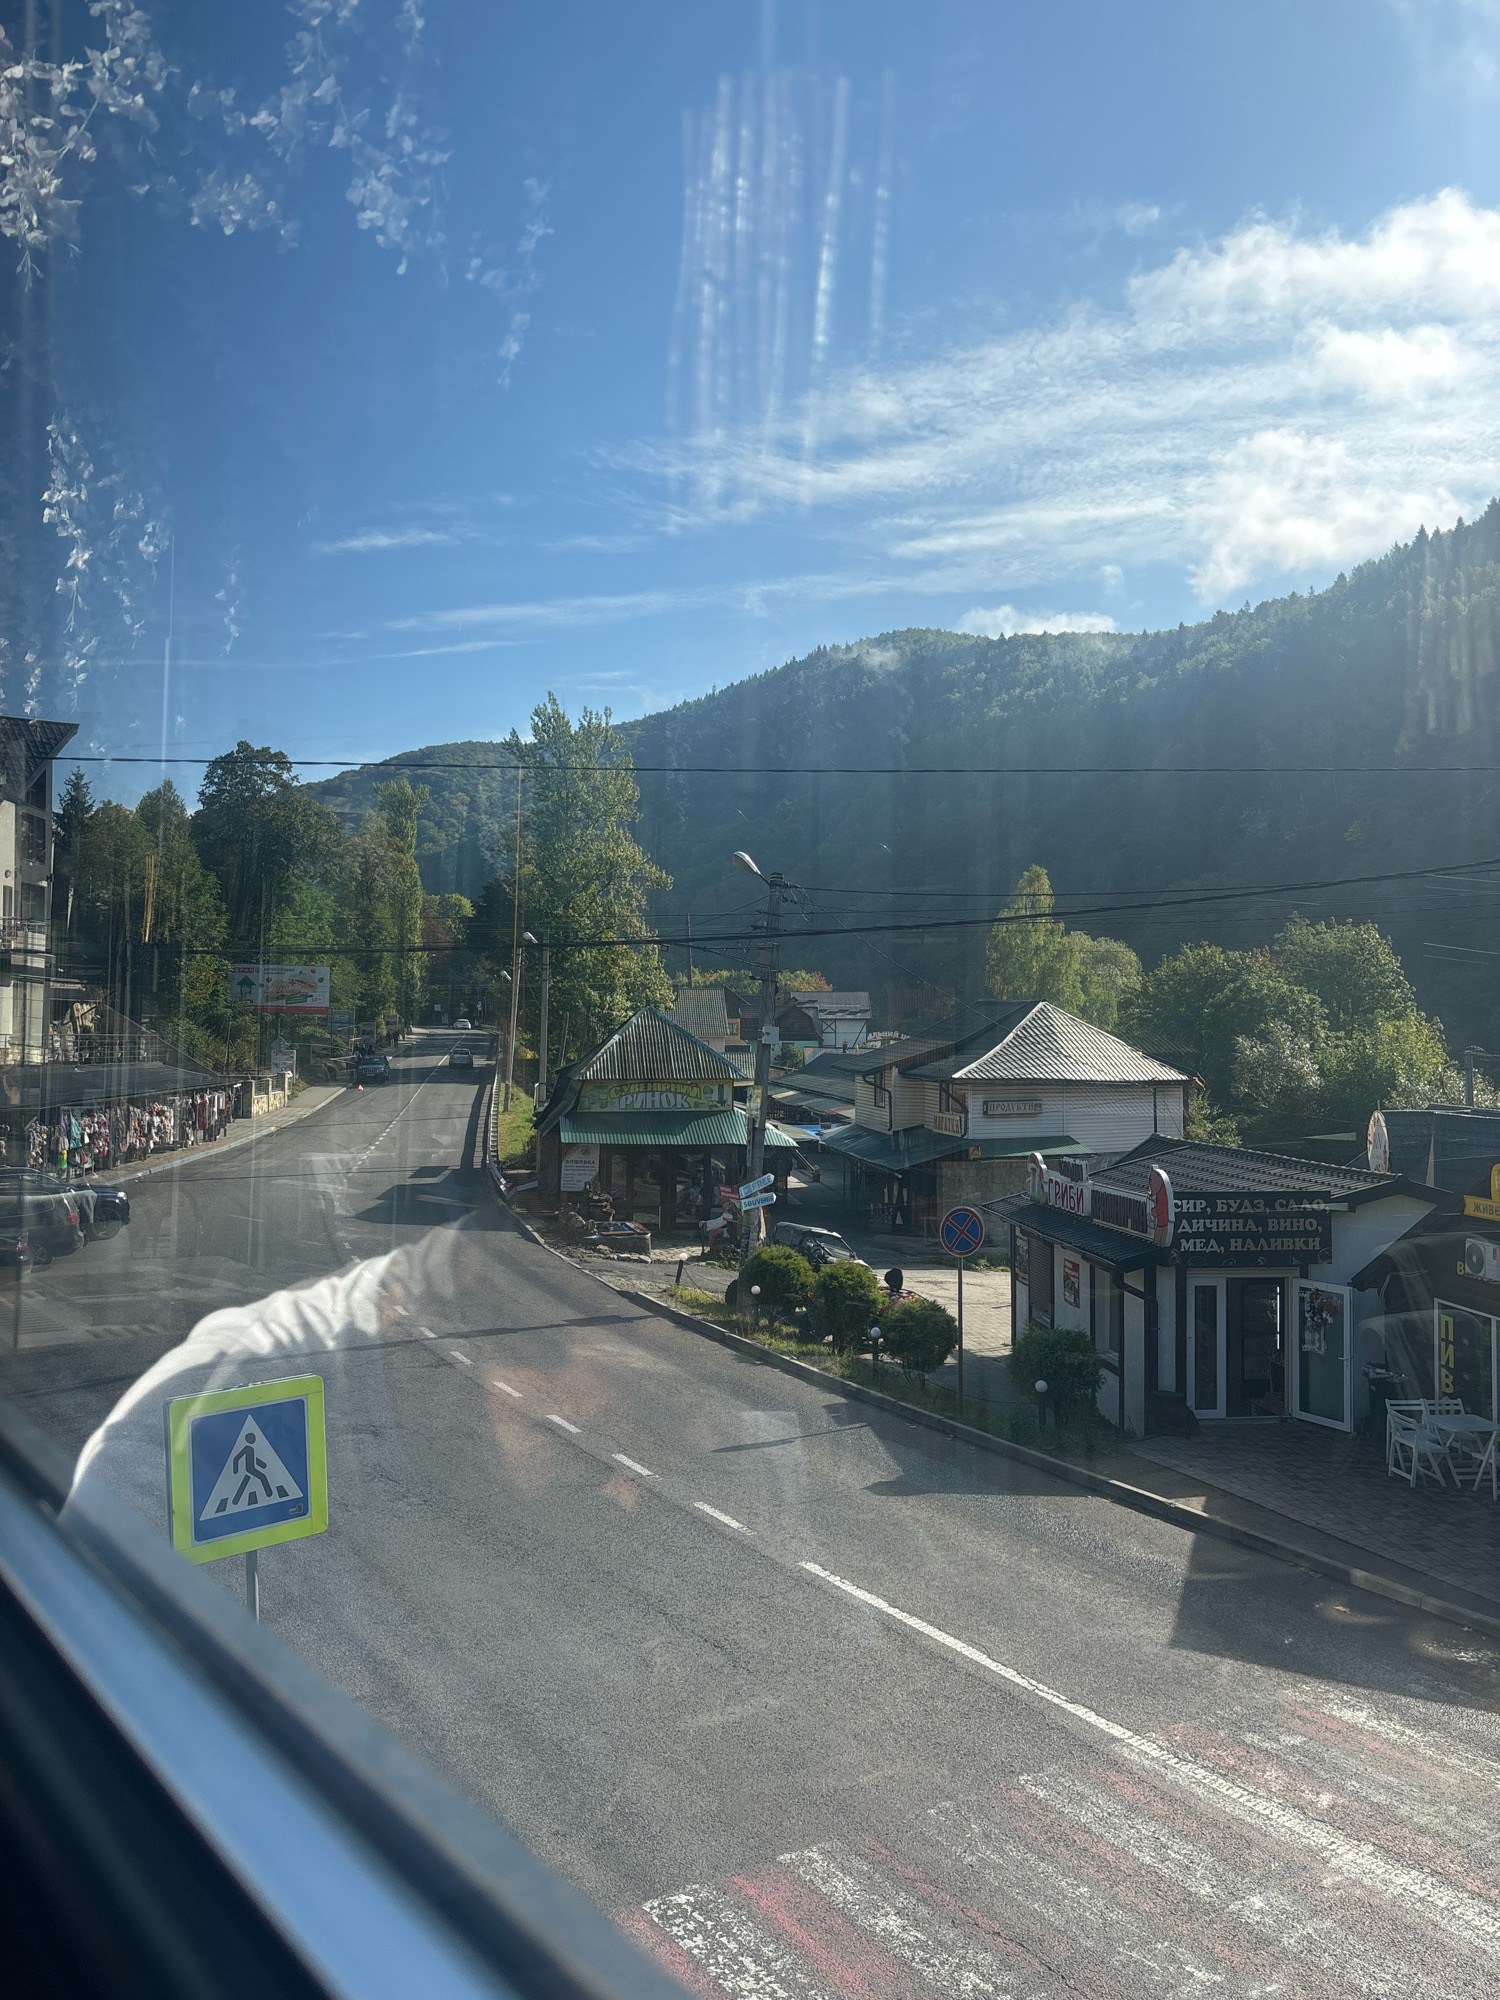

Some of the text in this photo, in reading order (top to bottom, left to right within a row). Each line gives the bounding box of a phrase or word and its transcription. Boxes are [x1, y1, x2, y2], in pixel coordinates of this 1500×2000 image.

[609, 1081, 699, 1099] СУВЕНІРНИЙ
[619, 1091, 691, 1109] РИНОК
[989, 1102, 1034, 1112] ПРОДУКТИ
[1048, 1178, 1085, 1217] ГРИБИ
[1173, 1199, 1330, 1214] СИР, БУДЗ, САЛО,
[1177, 1218, 1322, 1233] ДИЧИНА, ВИНО,
[1180, 1237, 1321, 1254] МЕД, НАЛИВКИ
